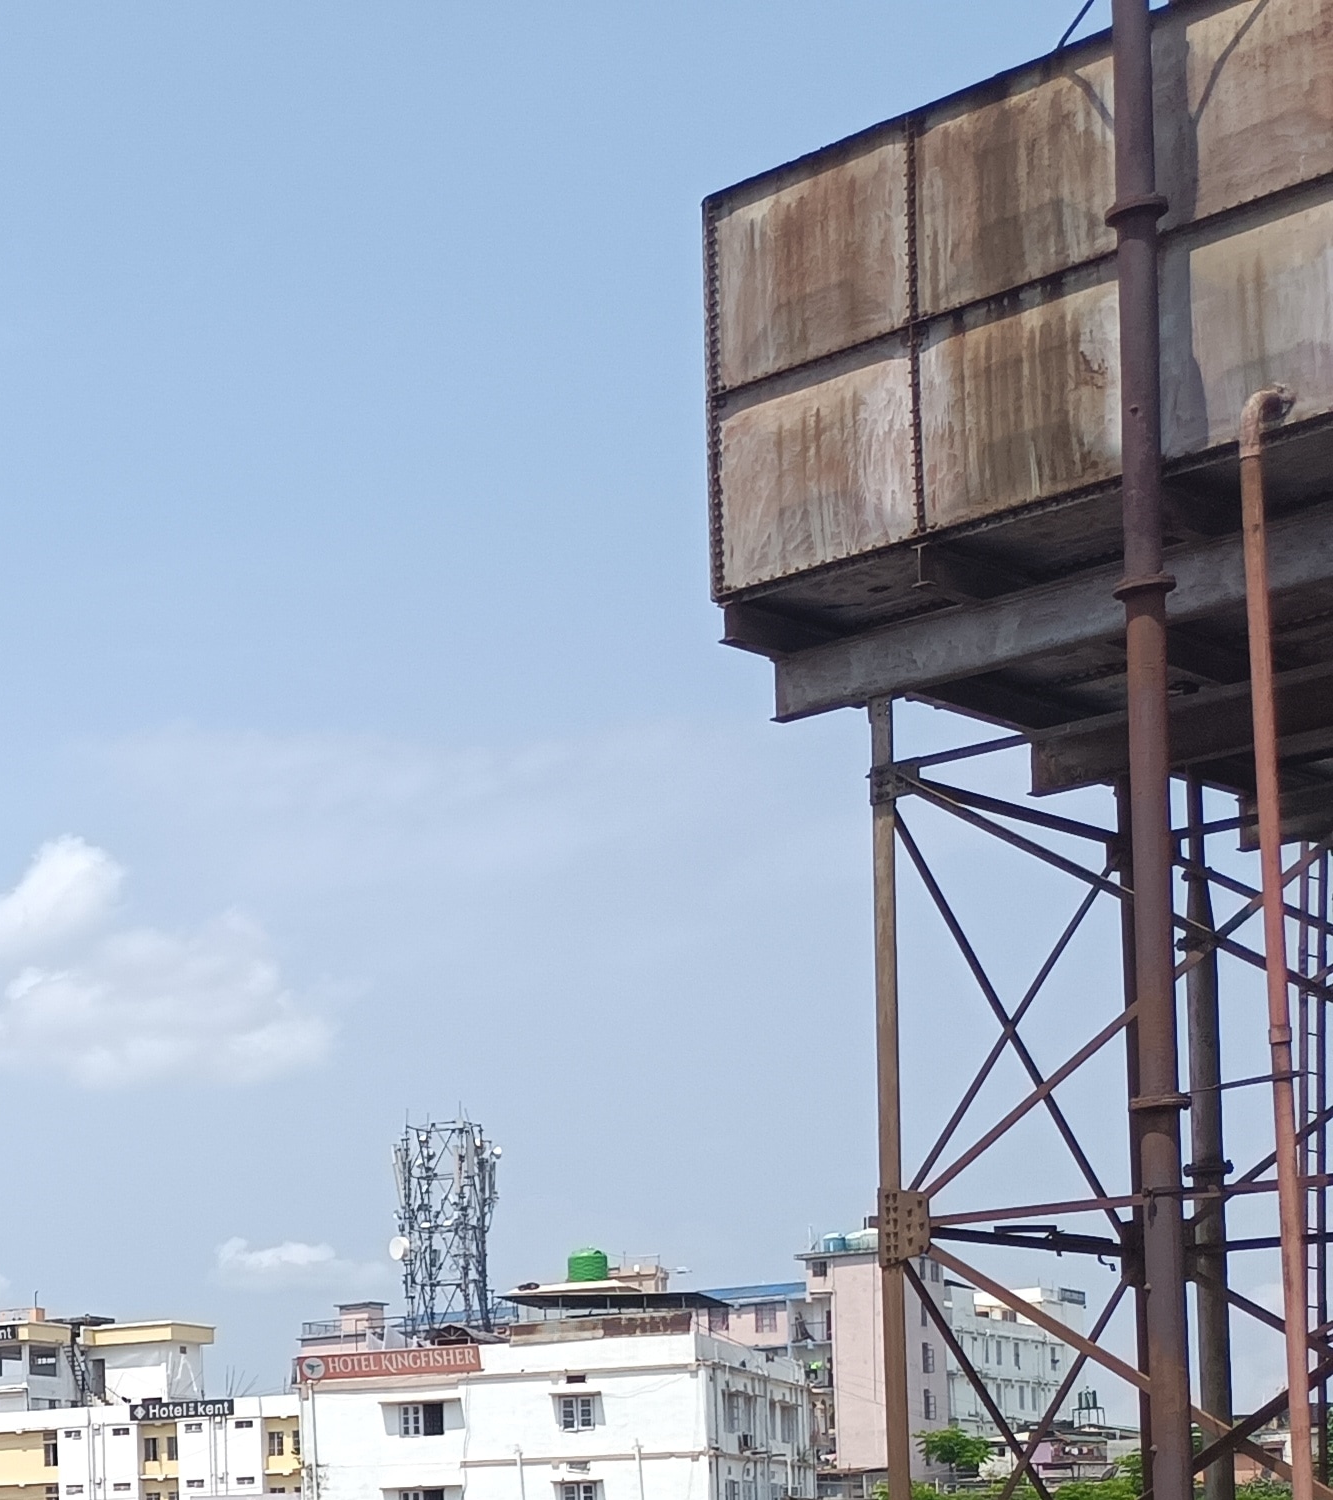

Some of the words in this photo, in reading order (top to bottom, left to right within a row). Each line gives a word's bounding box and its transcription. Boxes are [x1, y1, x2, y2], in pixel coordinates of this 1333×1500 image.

[328, 1355, 379, 1373] HOTEL
[382, 1348, 476, 1373] KINGFISHER
[148, 1402, 187, 1418] Hotel
[197, 1401, 229, 1415] kent
